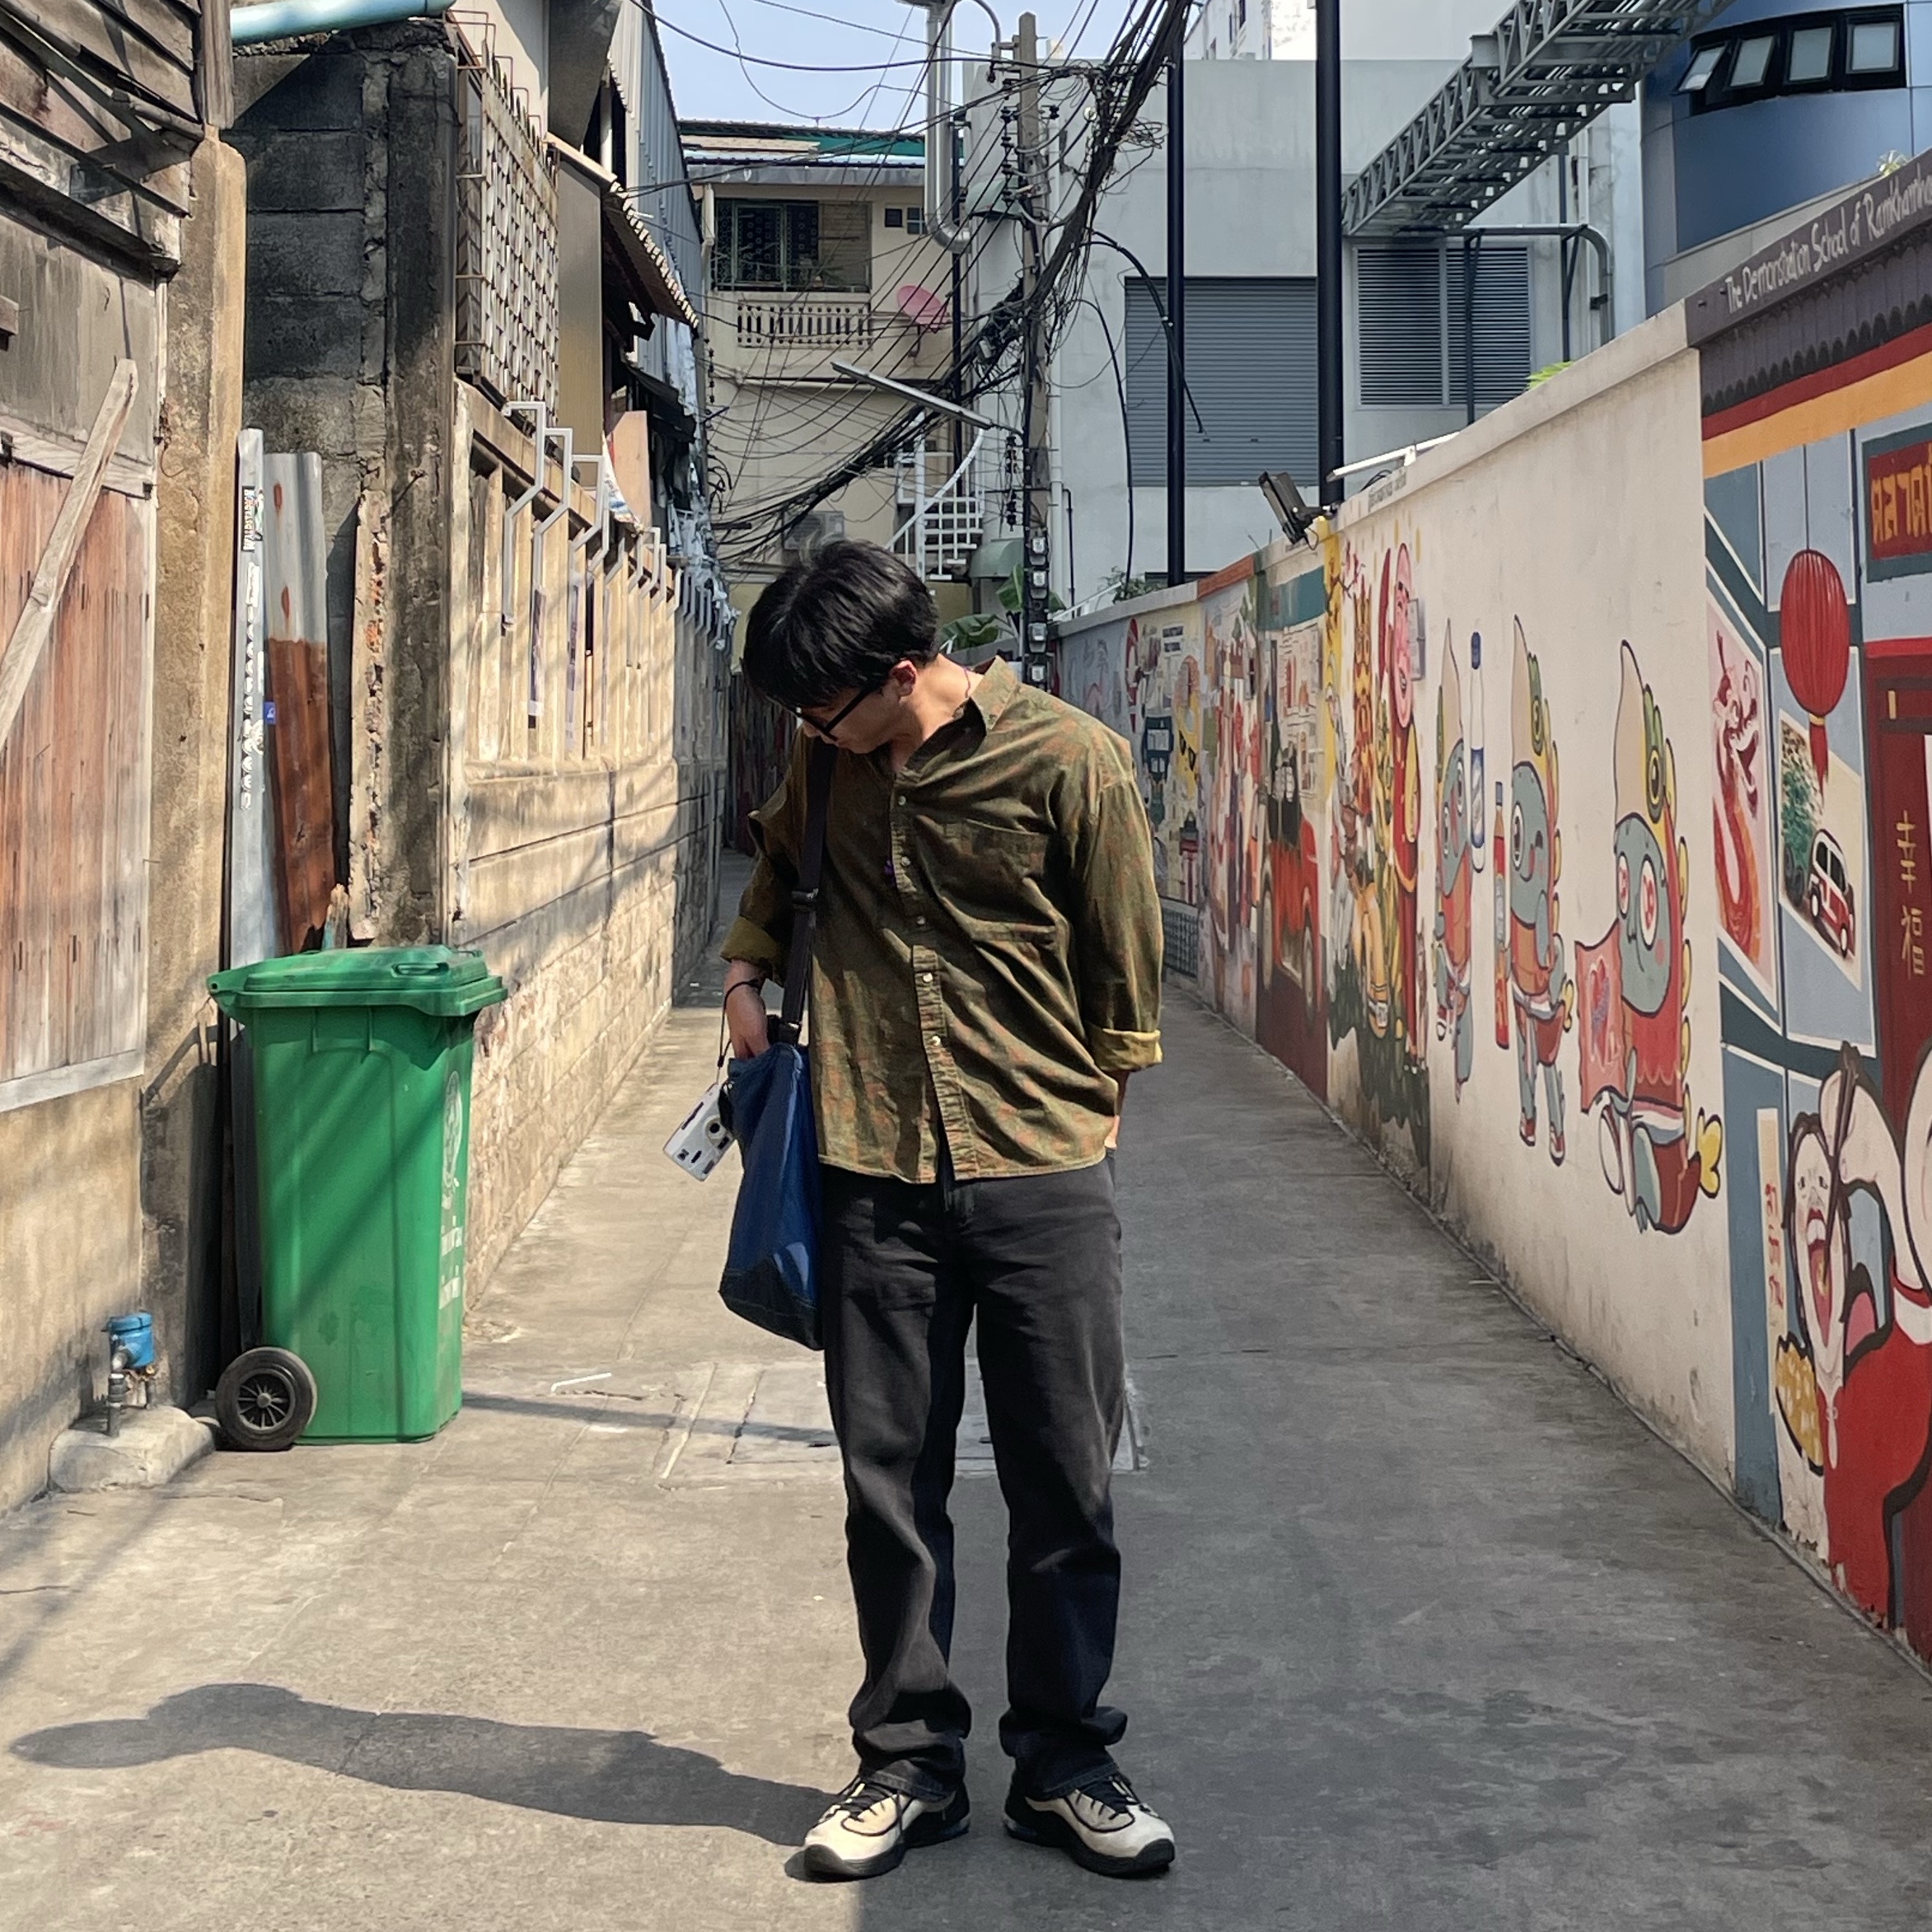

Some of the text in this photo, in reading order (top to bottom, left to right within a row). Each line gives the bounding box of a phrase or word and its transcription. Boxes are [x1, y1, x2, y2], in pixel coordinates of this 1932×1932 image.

[1724, 276, 1743, 314] The
[1812, 206, 1849, 273] School
[1850, 200, 1861, 246] of
